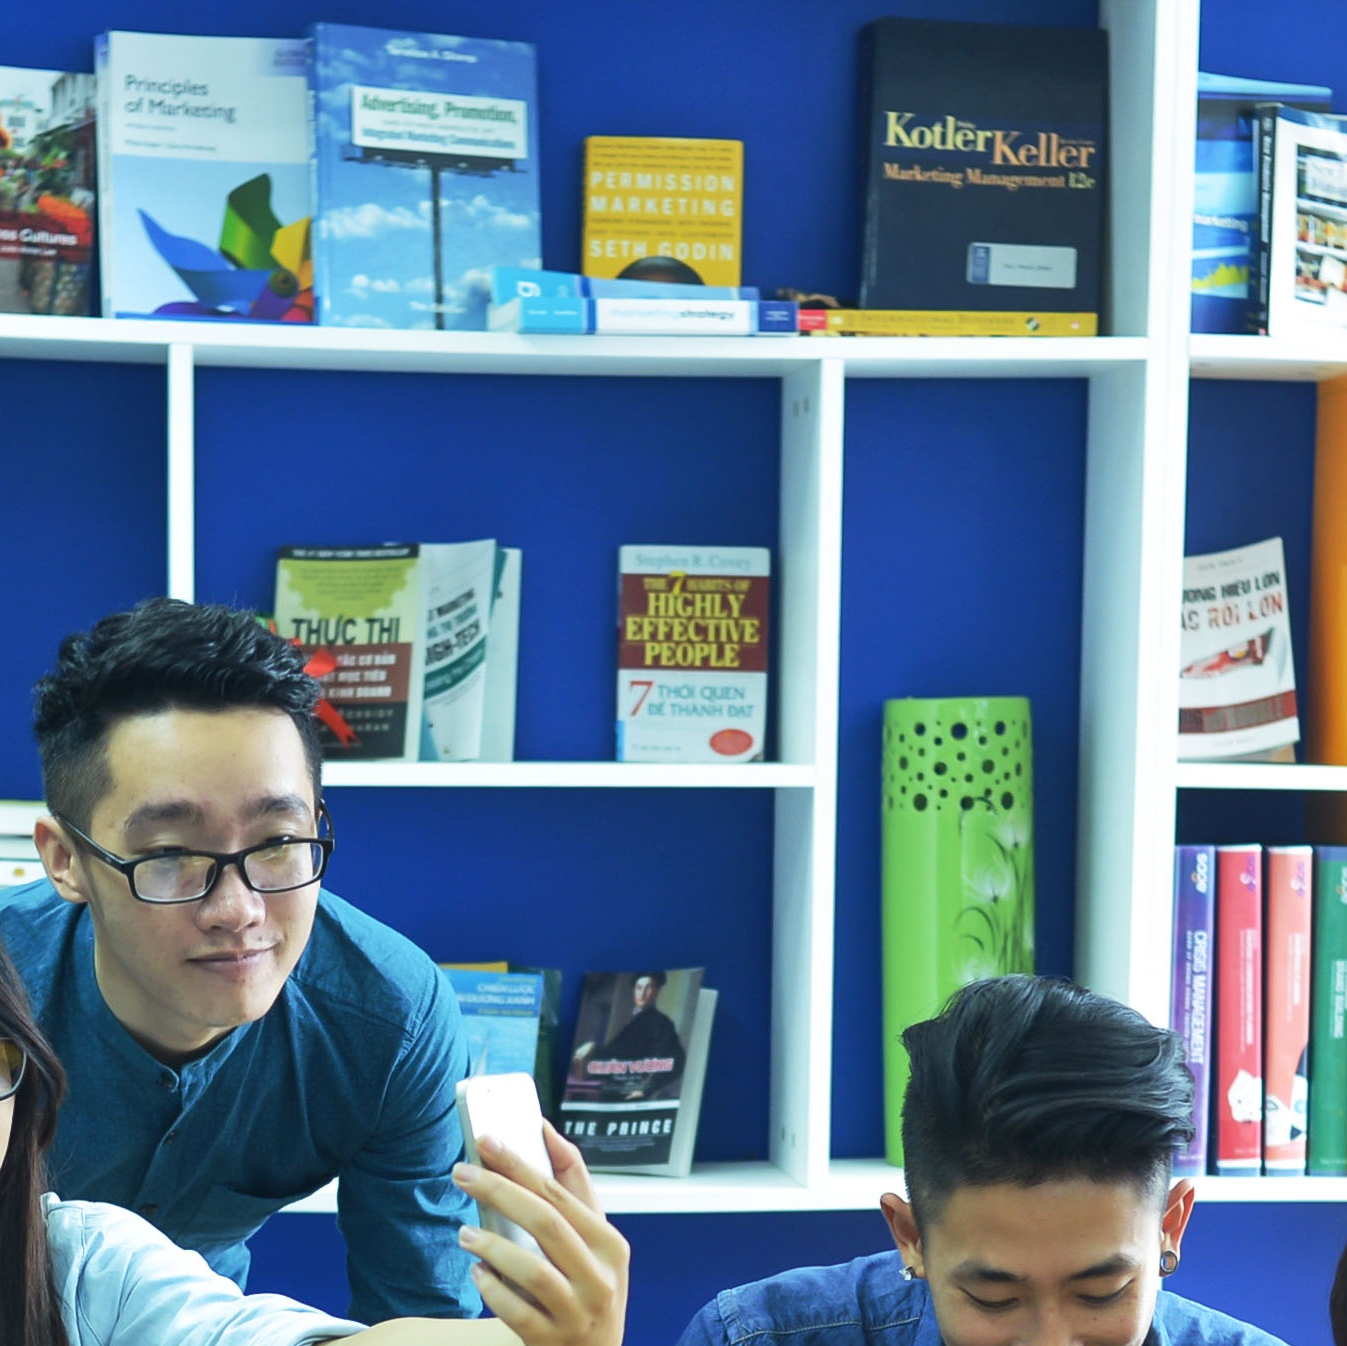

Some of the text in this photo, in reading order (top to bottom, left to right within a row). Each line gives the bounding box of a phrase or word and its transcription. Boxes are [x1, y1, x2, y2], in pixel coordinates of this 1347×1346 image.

[125, 74, 209, 97] Principles
[125, 98, 237, 125] of Marketing
[362, 94, 440, 121] Advertising,
[884, 111, 1096, 168] Kotler Keller
[590, 171, 735, 192] PERMISSION
[884, 162, 964, 188] Marketing
[965, 167, 1065, 191] Management
[589, 195, 734, 217] MARKETING
[19, 228, 78, 247] Cultures
[588, 239, 734, 261] SETH GODIN
[669, 570, 686, 596] 7
[647, 592, 746, 618] HIGHLY
[366, 617, 400, 645] THI
[626, 616, 761, 644] EFFECTIVE
[644, 641, 741, 668] PEOPLE
[629, 680, 654, 717] 7
[700, 686, 745, 700] QUEN
[1189, 930, 1208, 1066] CRISIS MANAGEMENT
[564, 1119, 672, 1136] THE PRINCE
